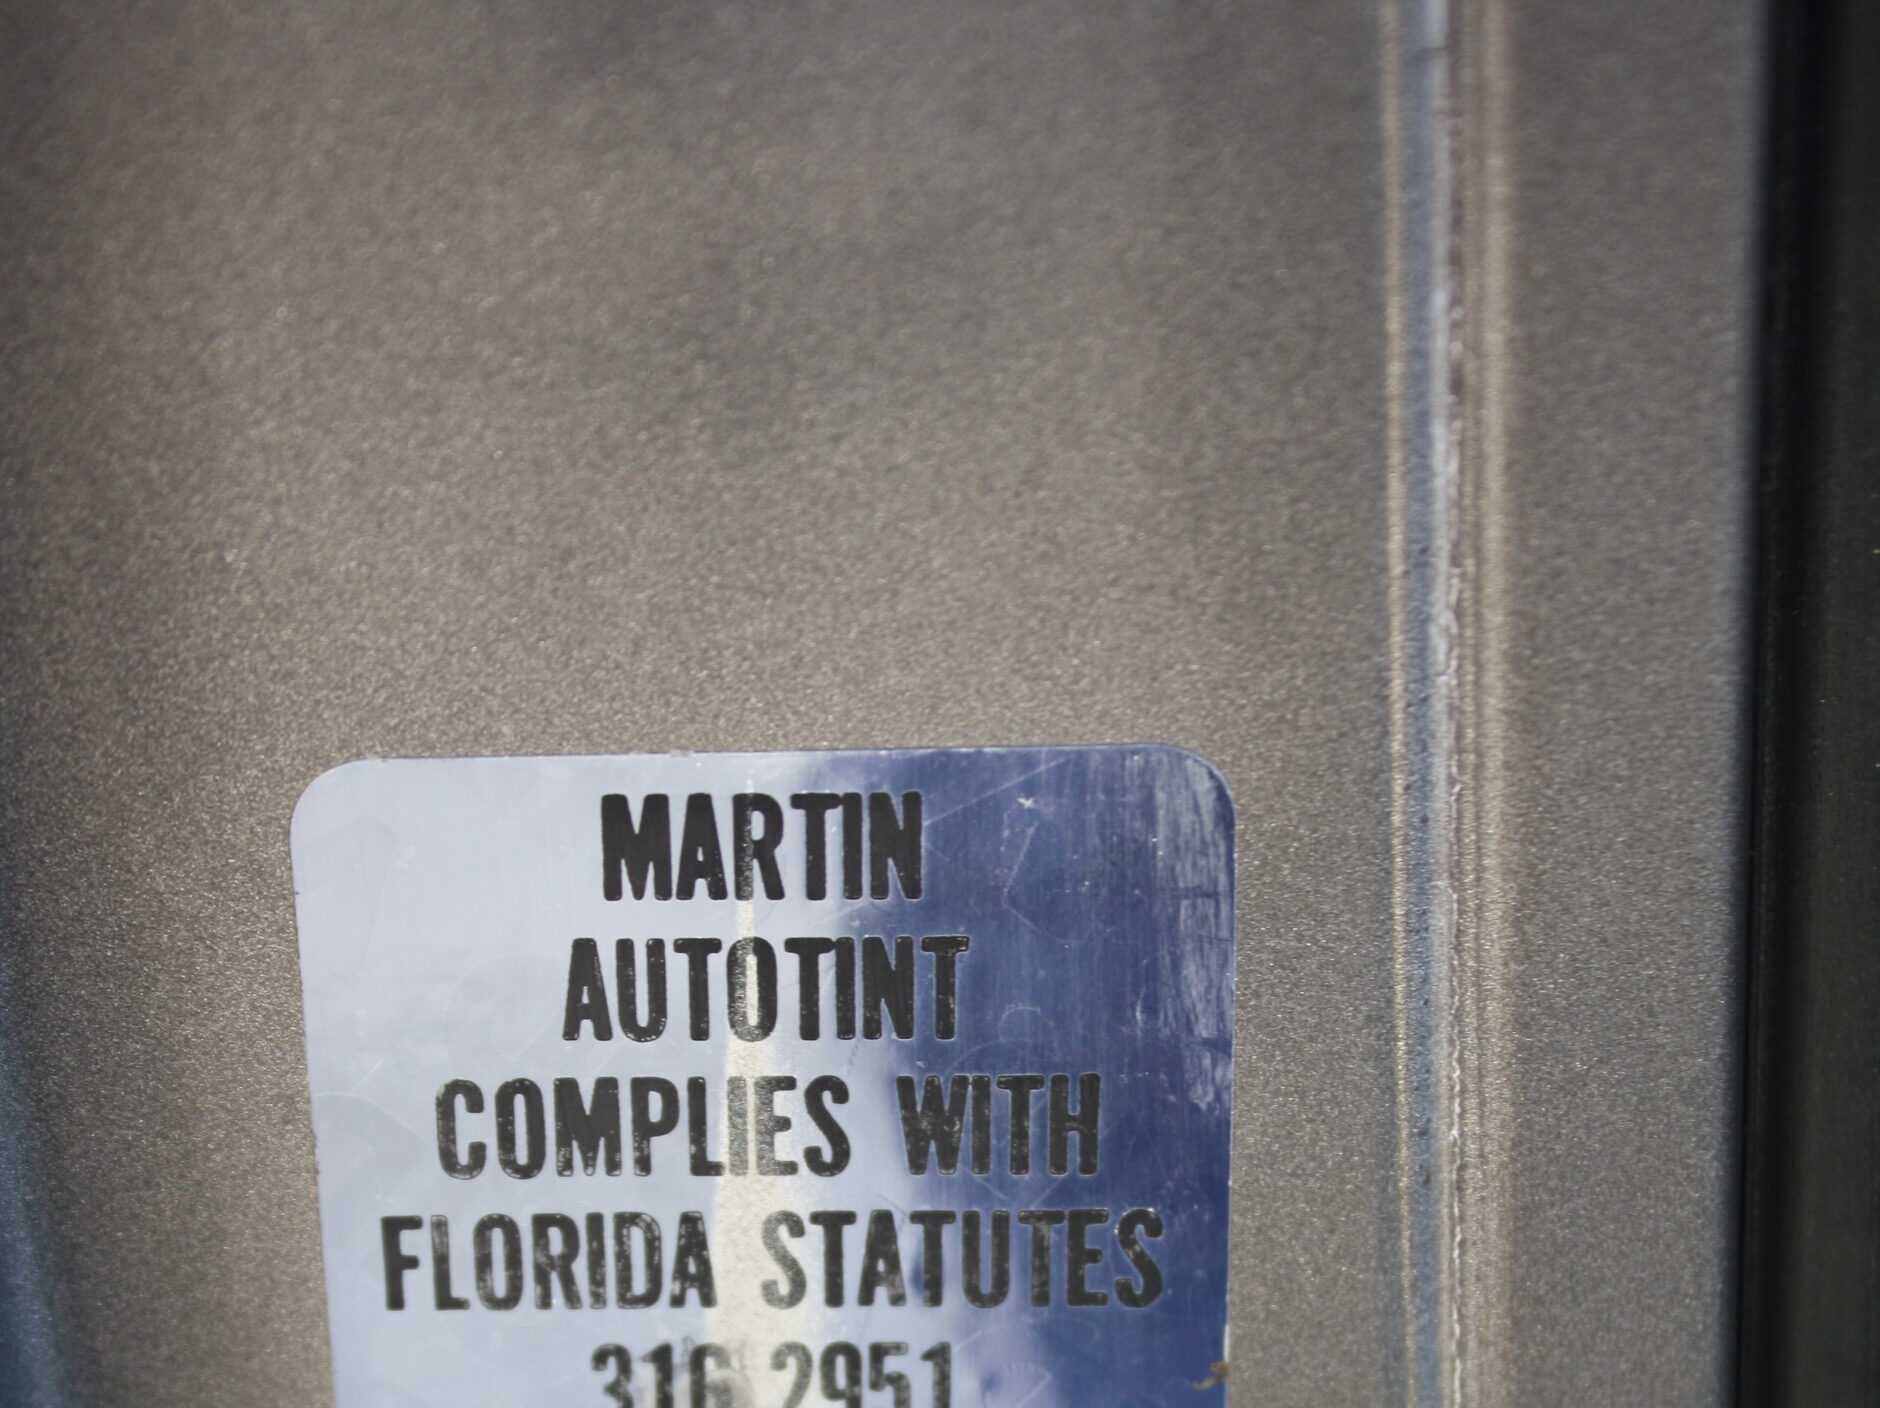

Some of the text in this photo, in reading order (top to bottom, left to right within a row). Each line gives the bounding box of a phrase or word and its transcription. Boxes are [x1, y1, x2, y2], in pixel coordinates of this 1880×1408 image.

[601, 791, 923, 901] MARTIN
[561, 935, 970, 1042] AUTOTINT
[435, 1072, 1102, 1180] COMPLIES WITH
[380, 1208, 1165, 1312] FLORIDA STATUTES
